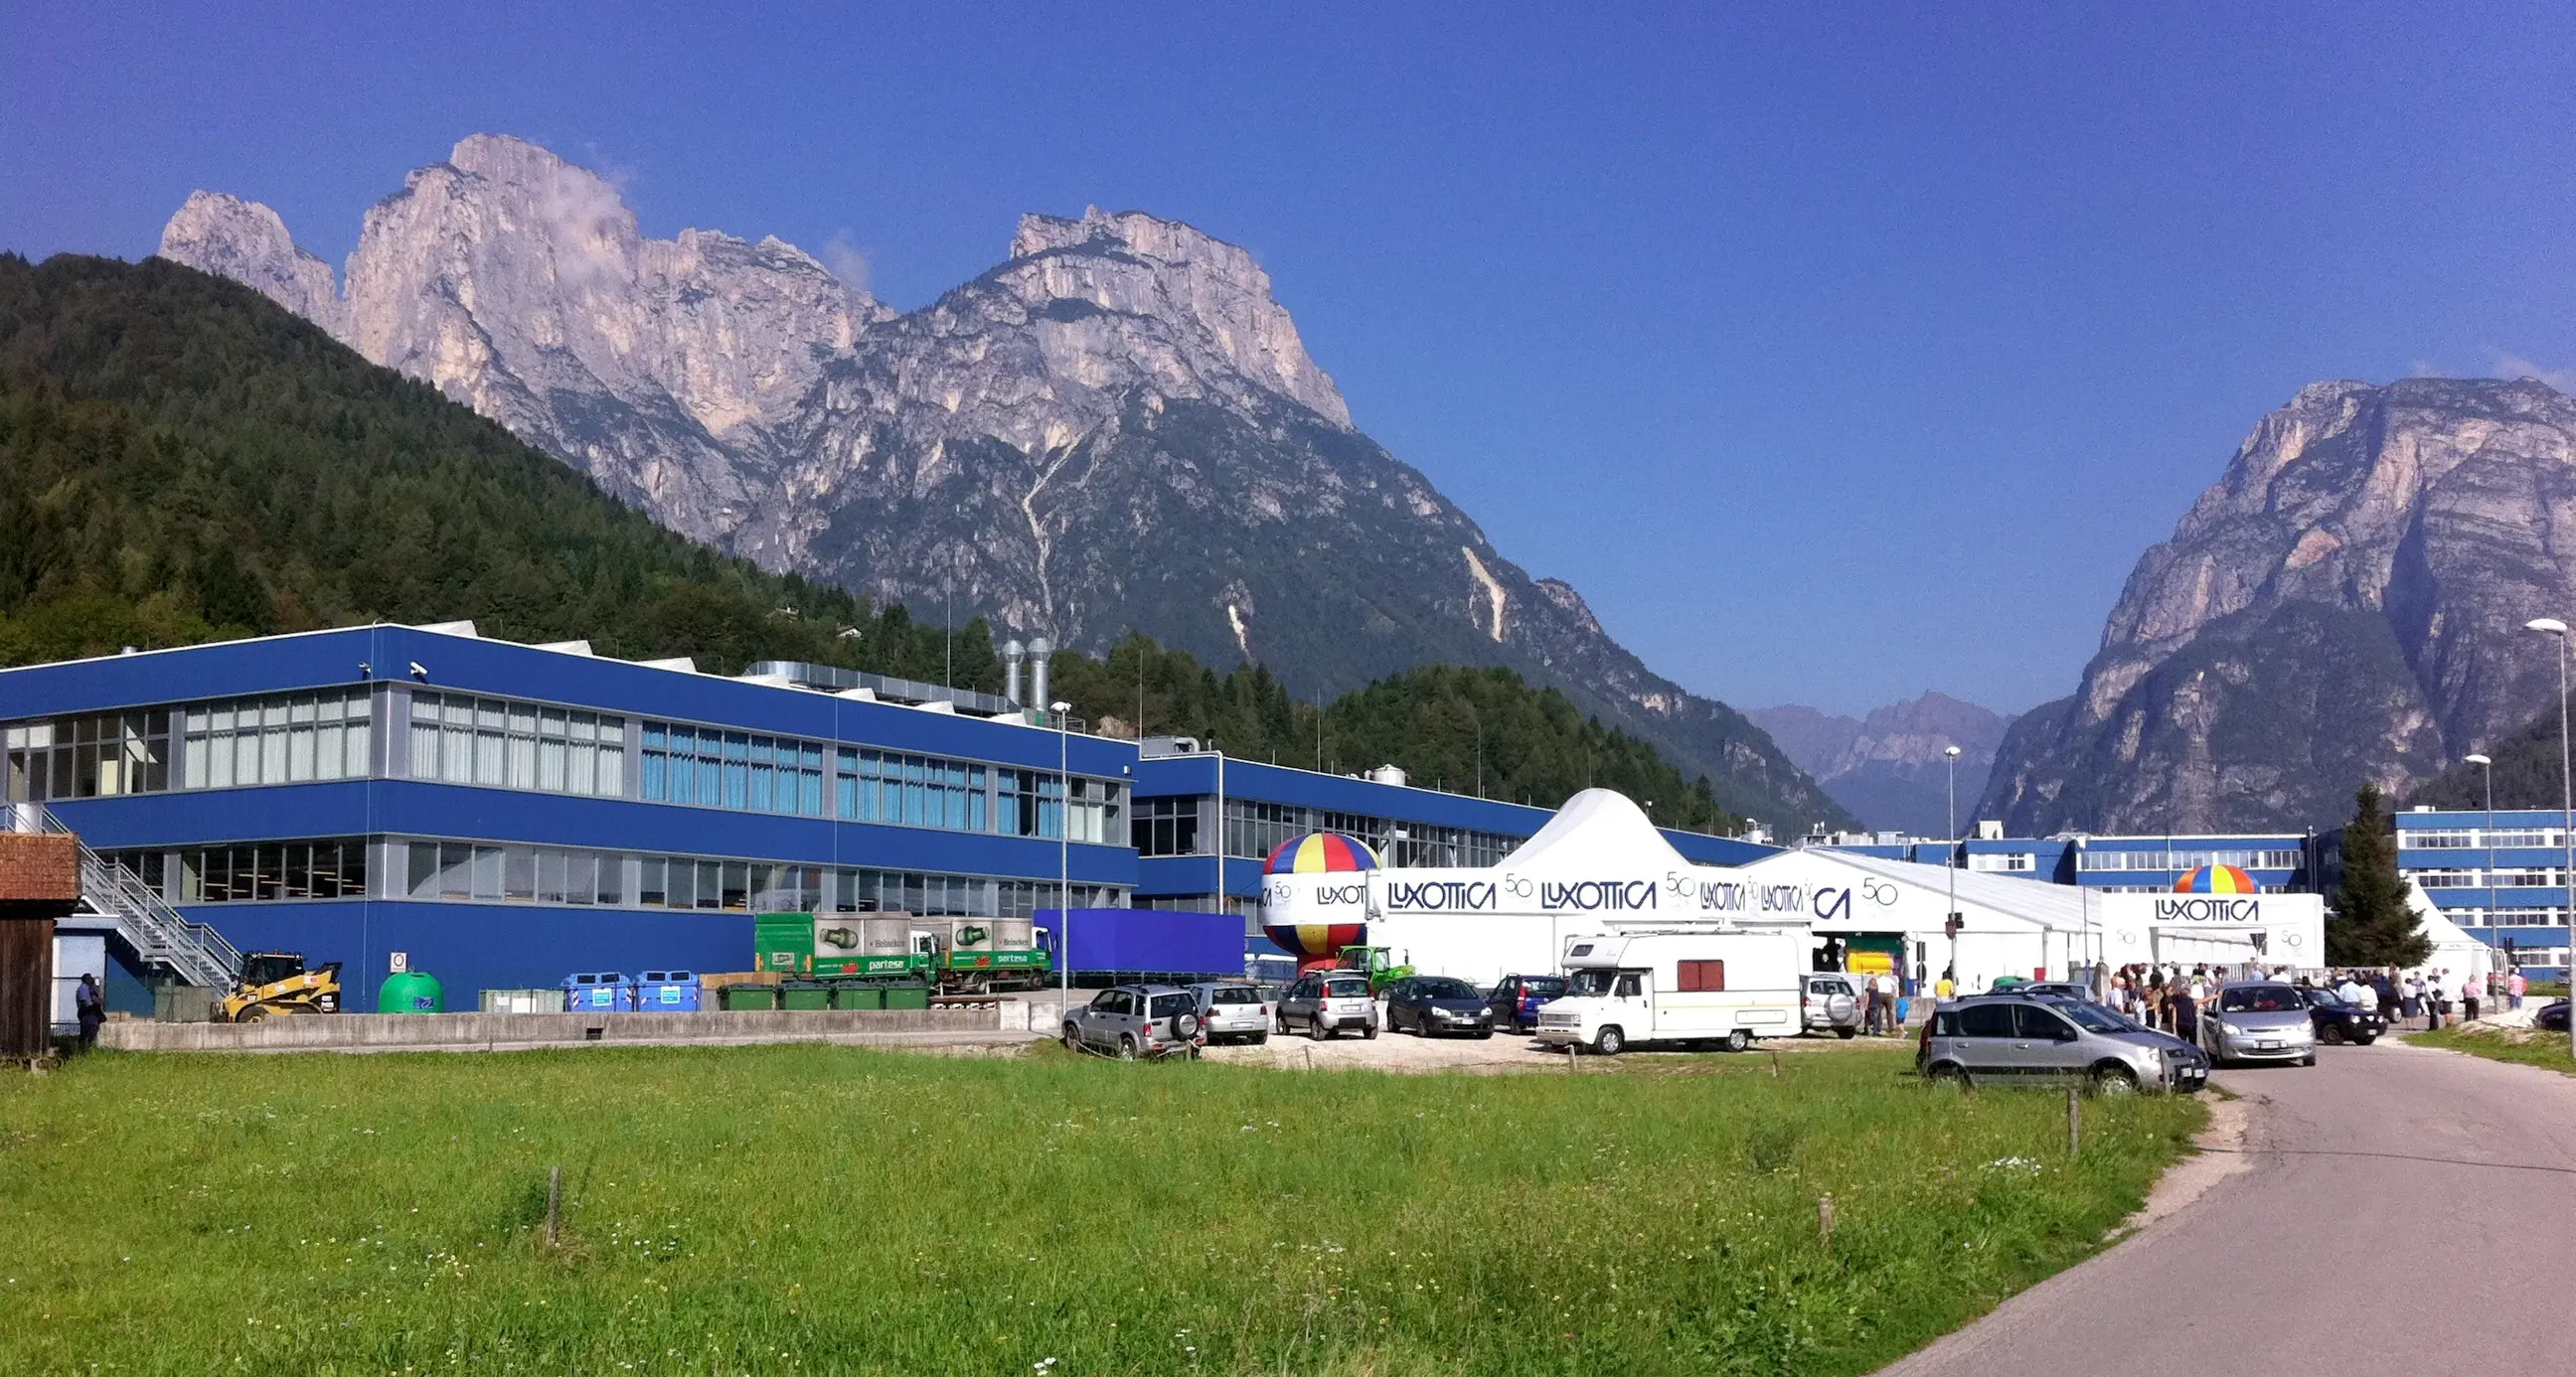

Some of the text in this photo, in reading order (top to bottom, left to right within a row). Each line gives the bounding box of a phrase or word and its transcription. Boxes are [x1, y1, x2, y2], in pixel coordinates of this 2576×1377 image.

[1387, 871, 1695, 910] LUXOTTICA 50 LUXOTTICA 50
[1700, 882, 1745, 911] LUXOTTICA
[1761, 884, 1804, 911] LUXOTTICA
[1862, 877, 1898, 905] 50
[2155, 899, 2259, 921] LUXOTTICA
[869, 960, 904, 972] partesa
